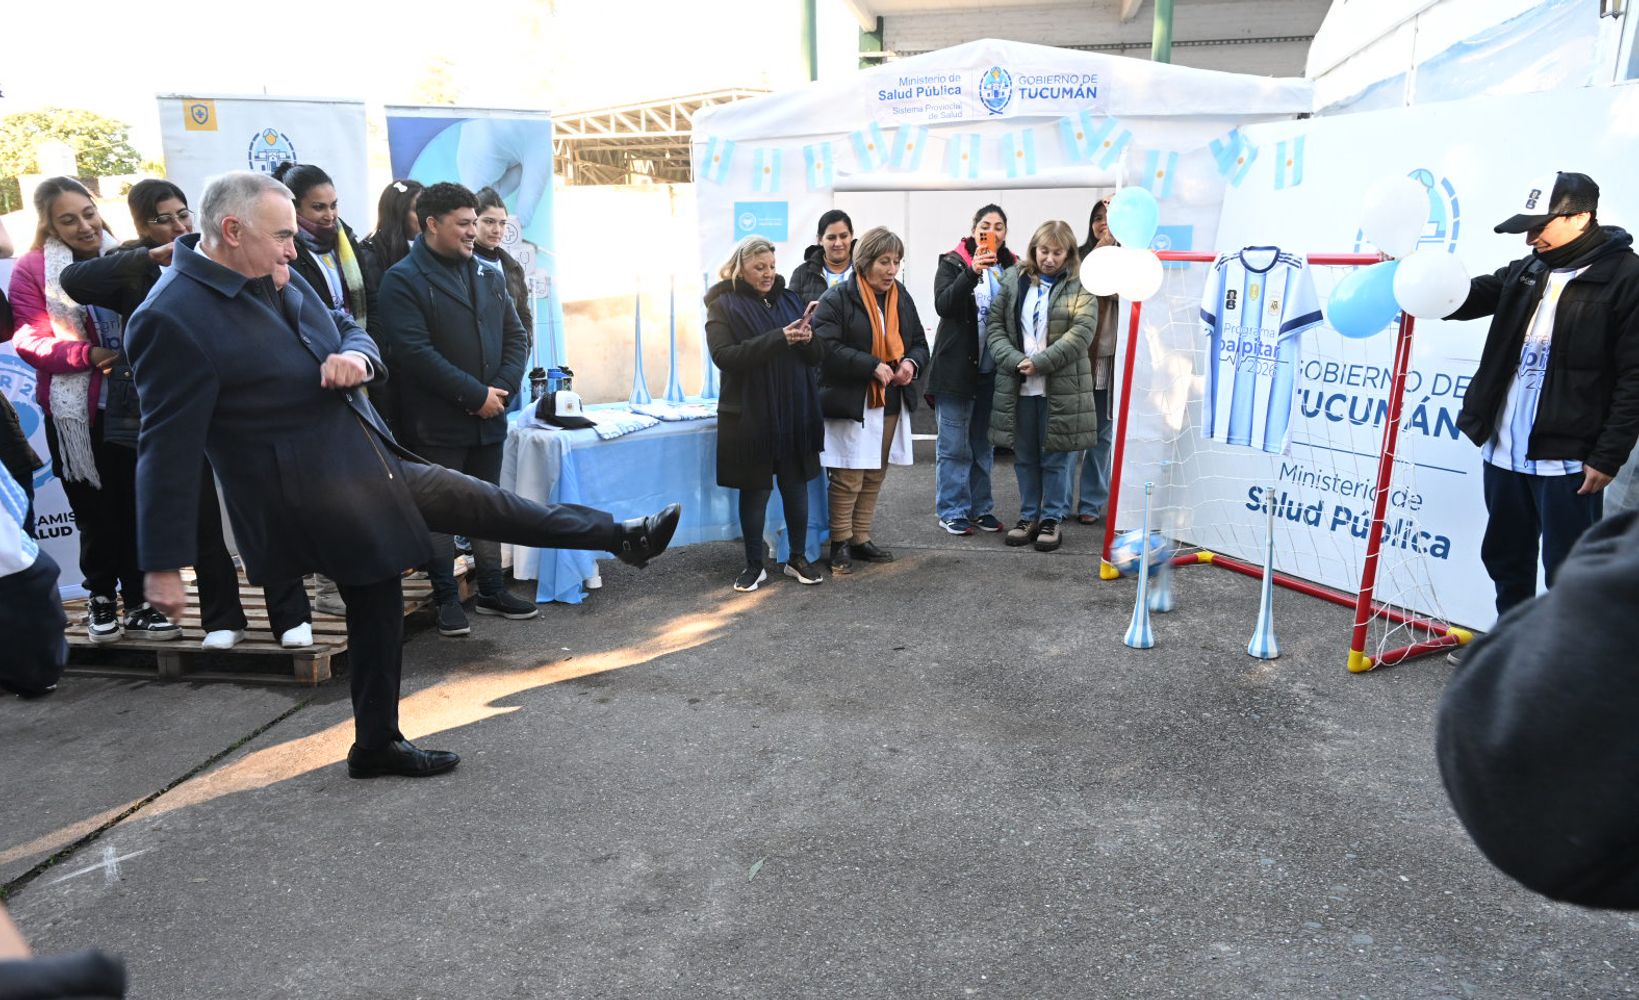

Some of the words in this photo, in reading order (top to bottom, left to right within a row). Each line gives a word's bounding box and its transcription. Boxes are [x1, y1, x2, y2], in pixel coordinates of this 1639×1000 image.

[899, 74, 946, 87] Ministerio
[948, 72, 961, 83] de
[1018, 74, 1079, 85] GOBIERNO
[1082, 73, 1098, 84] DE
[878, 88, 913, 101] Salud
[916, 84, 961, 98] Pública
[1018, 83, 1097, 99] TUCUMÁN
[892, 105, 924, 115] Sistema
[928, 112, 939, 120] de
[940, 110, 963, 119] Salud
[1224, 322, 1275, 339] Programa
[1299, 359, 1423, 393] OBIERNO
[1431, 373, 1473, 399] DE
[1391, 486, 1423, 511] de
